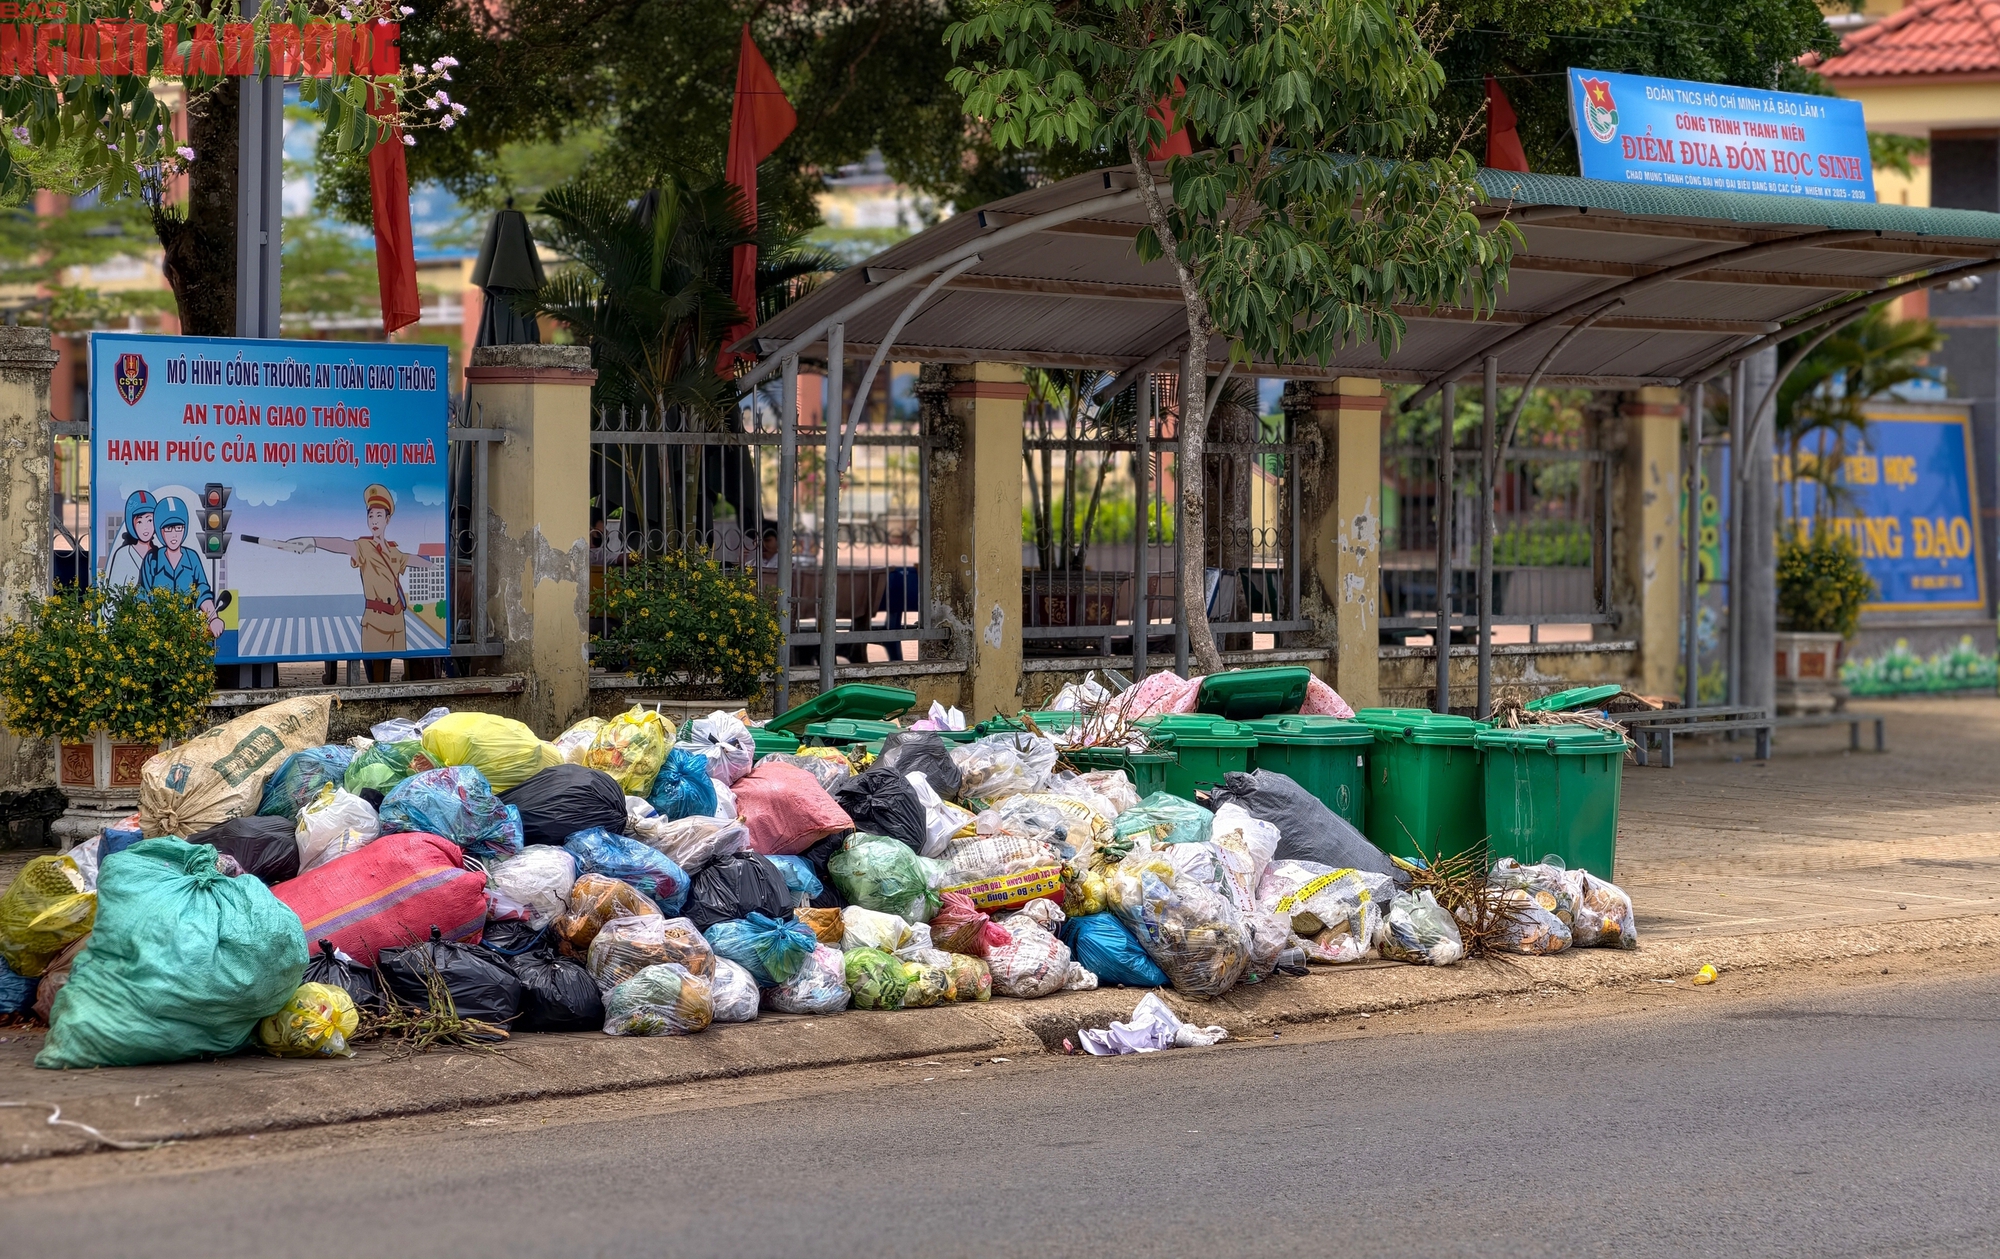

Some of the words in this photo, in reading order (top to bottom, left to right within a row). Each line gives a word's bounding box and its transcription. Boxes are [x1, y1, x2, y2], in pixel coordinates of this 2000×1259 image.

[1645, 84, 1674, 102] ĐOÀN
[1675, 89, 1702, 106] TNCS
[1720, 93, 1736, 109] CHÍ
[1738, 97, 1761, 112] MINH
[1762, 97, 1776, 113] XÃ
[1799, 101, 1819, 118] LÂM
[1820, 106, 1825, 118] 1
[1675, 111, 1706, 132] CÔNG
[1708, 115, 1741, 136] TRÌNH
[1743, 121, 1779, 139] THANH
[1781, 123, 1806, 142] NIÊN
[1621, 124, 1676, 163] ĐIỂM
[1679, 140, 1723, 168] ĐƯA
[1725, 140, 1767, 171] ĐÓN
[1772, 149, 1813, 181] HỌC
[1818, 154, 1864, 181] SINH
[1832, 188, 1847, 198] 2025
[1852, 189, 1866, 200] 2030
[119, 377, 144, 386] CSGT
[166, 354, 187, 385] MÔ
[191, 355, 221, 386] HÌNH
[225, 350, 259, 387] CỔNG
[263, 356, 311, 389] TRƯỜNG
[314, 363, 331, 389] AN
[334, 358, 365, 390] TOÀN
[368, 363, 395, 391] GIAO
[398, 360, 437, 392] THÔNG
[182, 403, 208, 426] AN
[213, 399, 261, 427] TOÀN
[267, 404, 307, 428] GIAO
[311, 401, 370, 429] THÔNG
[107, 439, 160, 466] HẠNH
[166, 435, 216, 463] PHÚC
[221, 434, 258, 464] CỦA
[263, 442, 297, 468] MỌI
[302, 437, 360, 468] NGƯỜI,
[365, 443, 397, 469] MỌI
[402, 437, 437, 465] NHÀ
[1883, 455, 1917, 492] HỌC
[1911, 516, 1972, 568] ĐẠO
